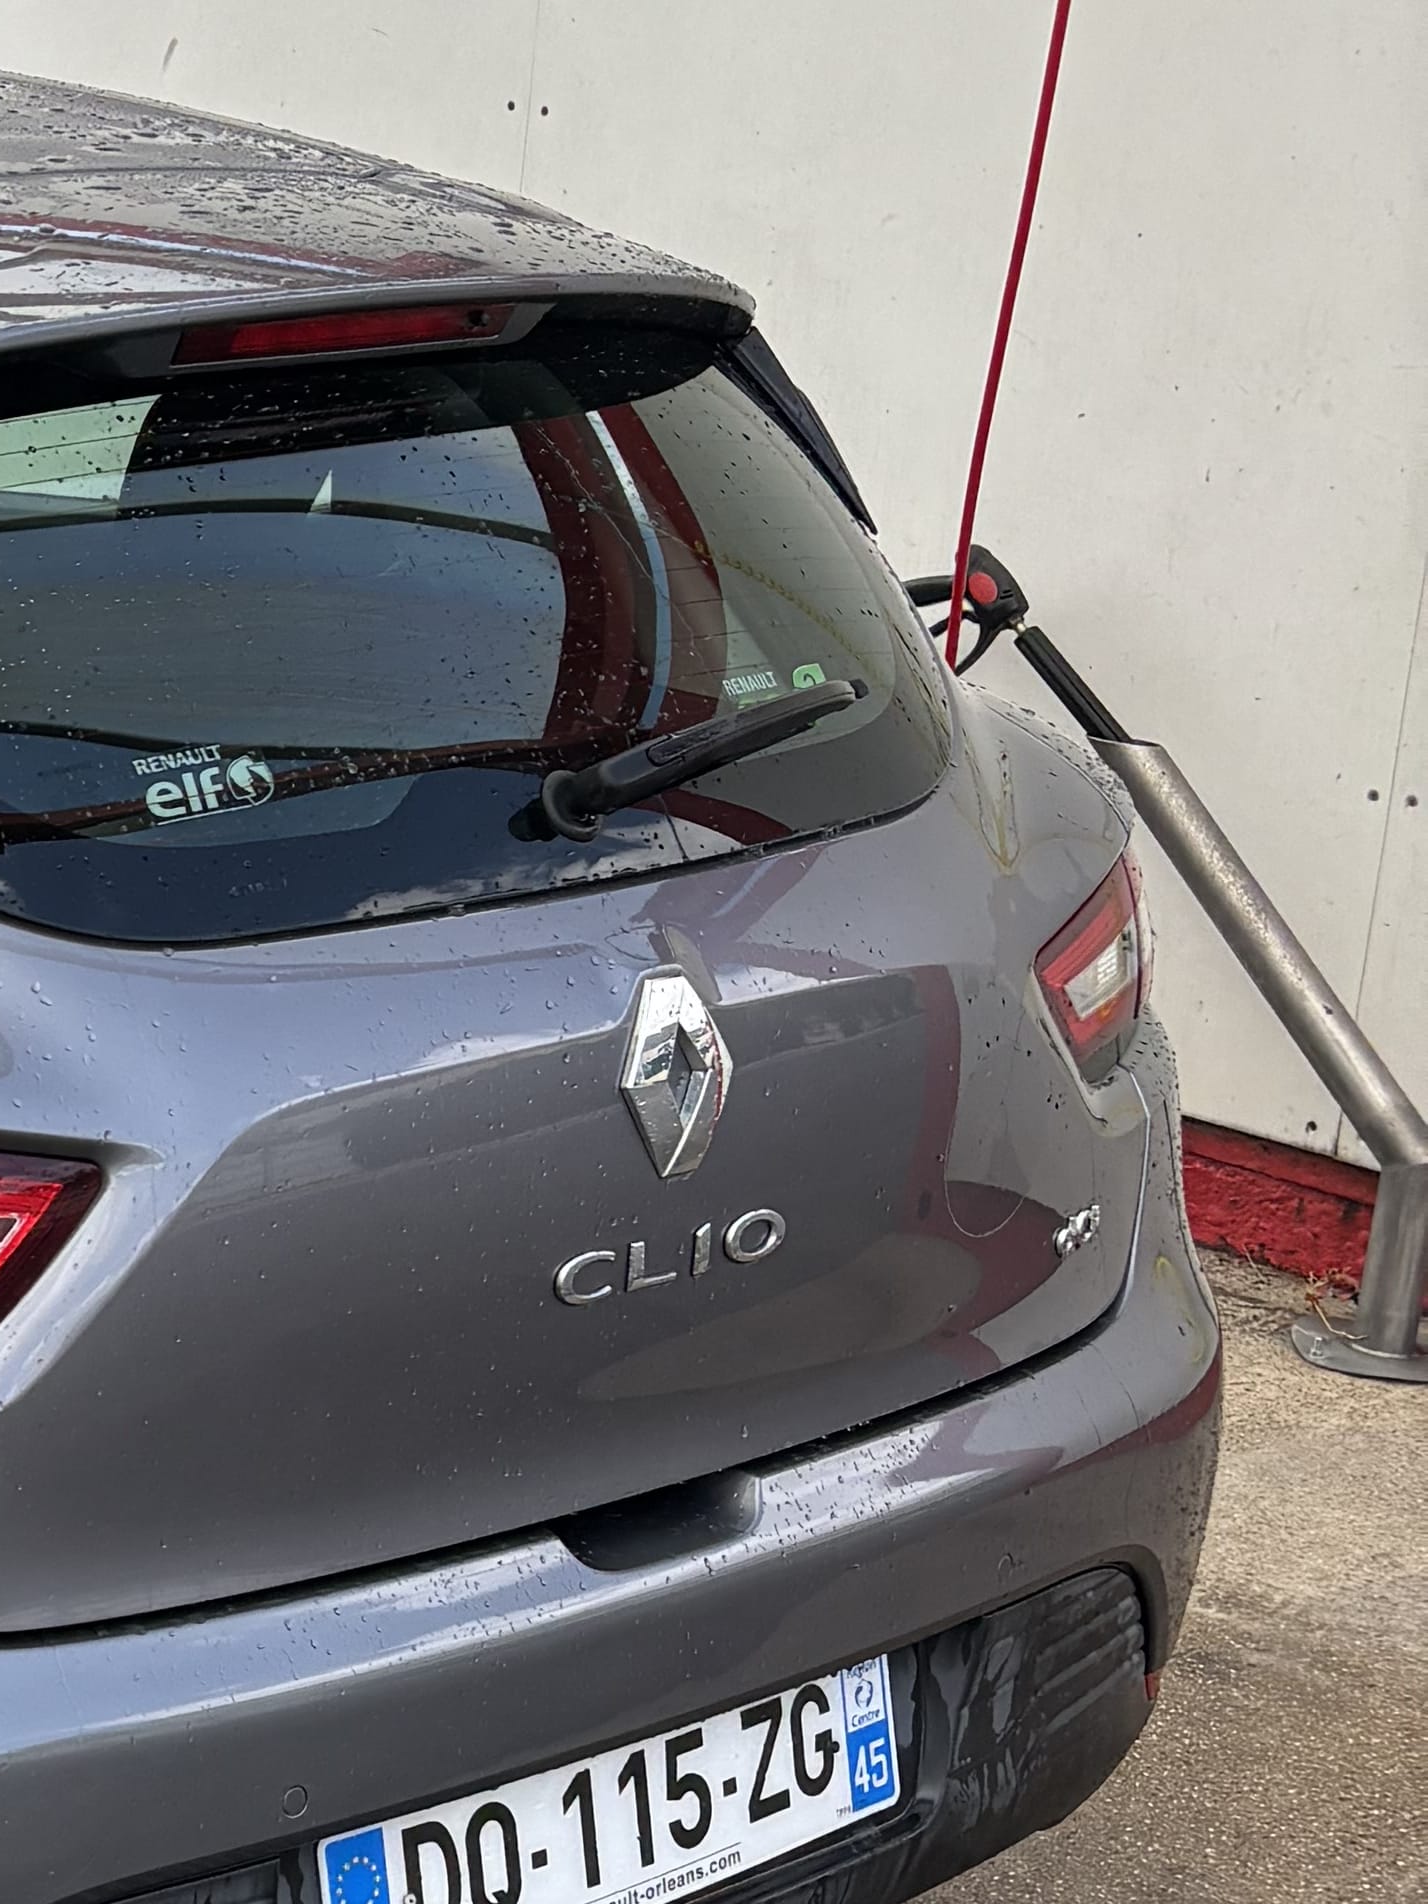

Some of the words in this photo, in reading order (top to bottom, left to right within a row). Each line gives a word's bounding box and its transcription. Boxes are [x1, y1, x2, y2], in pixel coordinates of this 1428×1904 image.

[722, 671, 778, 697] RENAULT
[132, 744, 222, 776] RENAULT
[145, 766, 224, 818] elf
[553, 1208, 786, 1306] CLIO
[851, 1708, 881, 1728] Centre
[855, 1737, 888, 1793] 45
